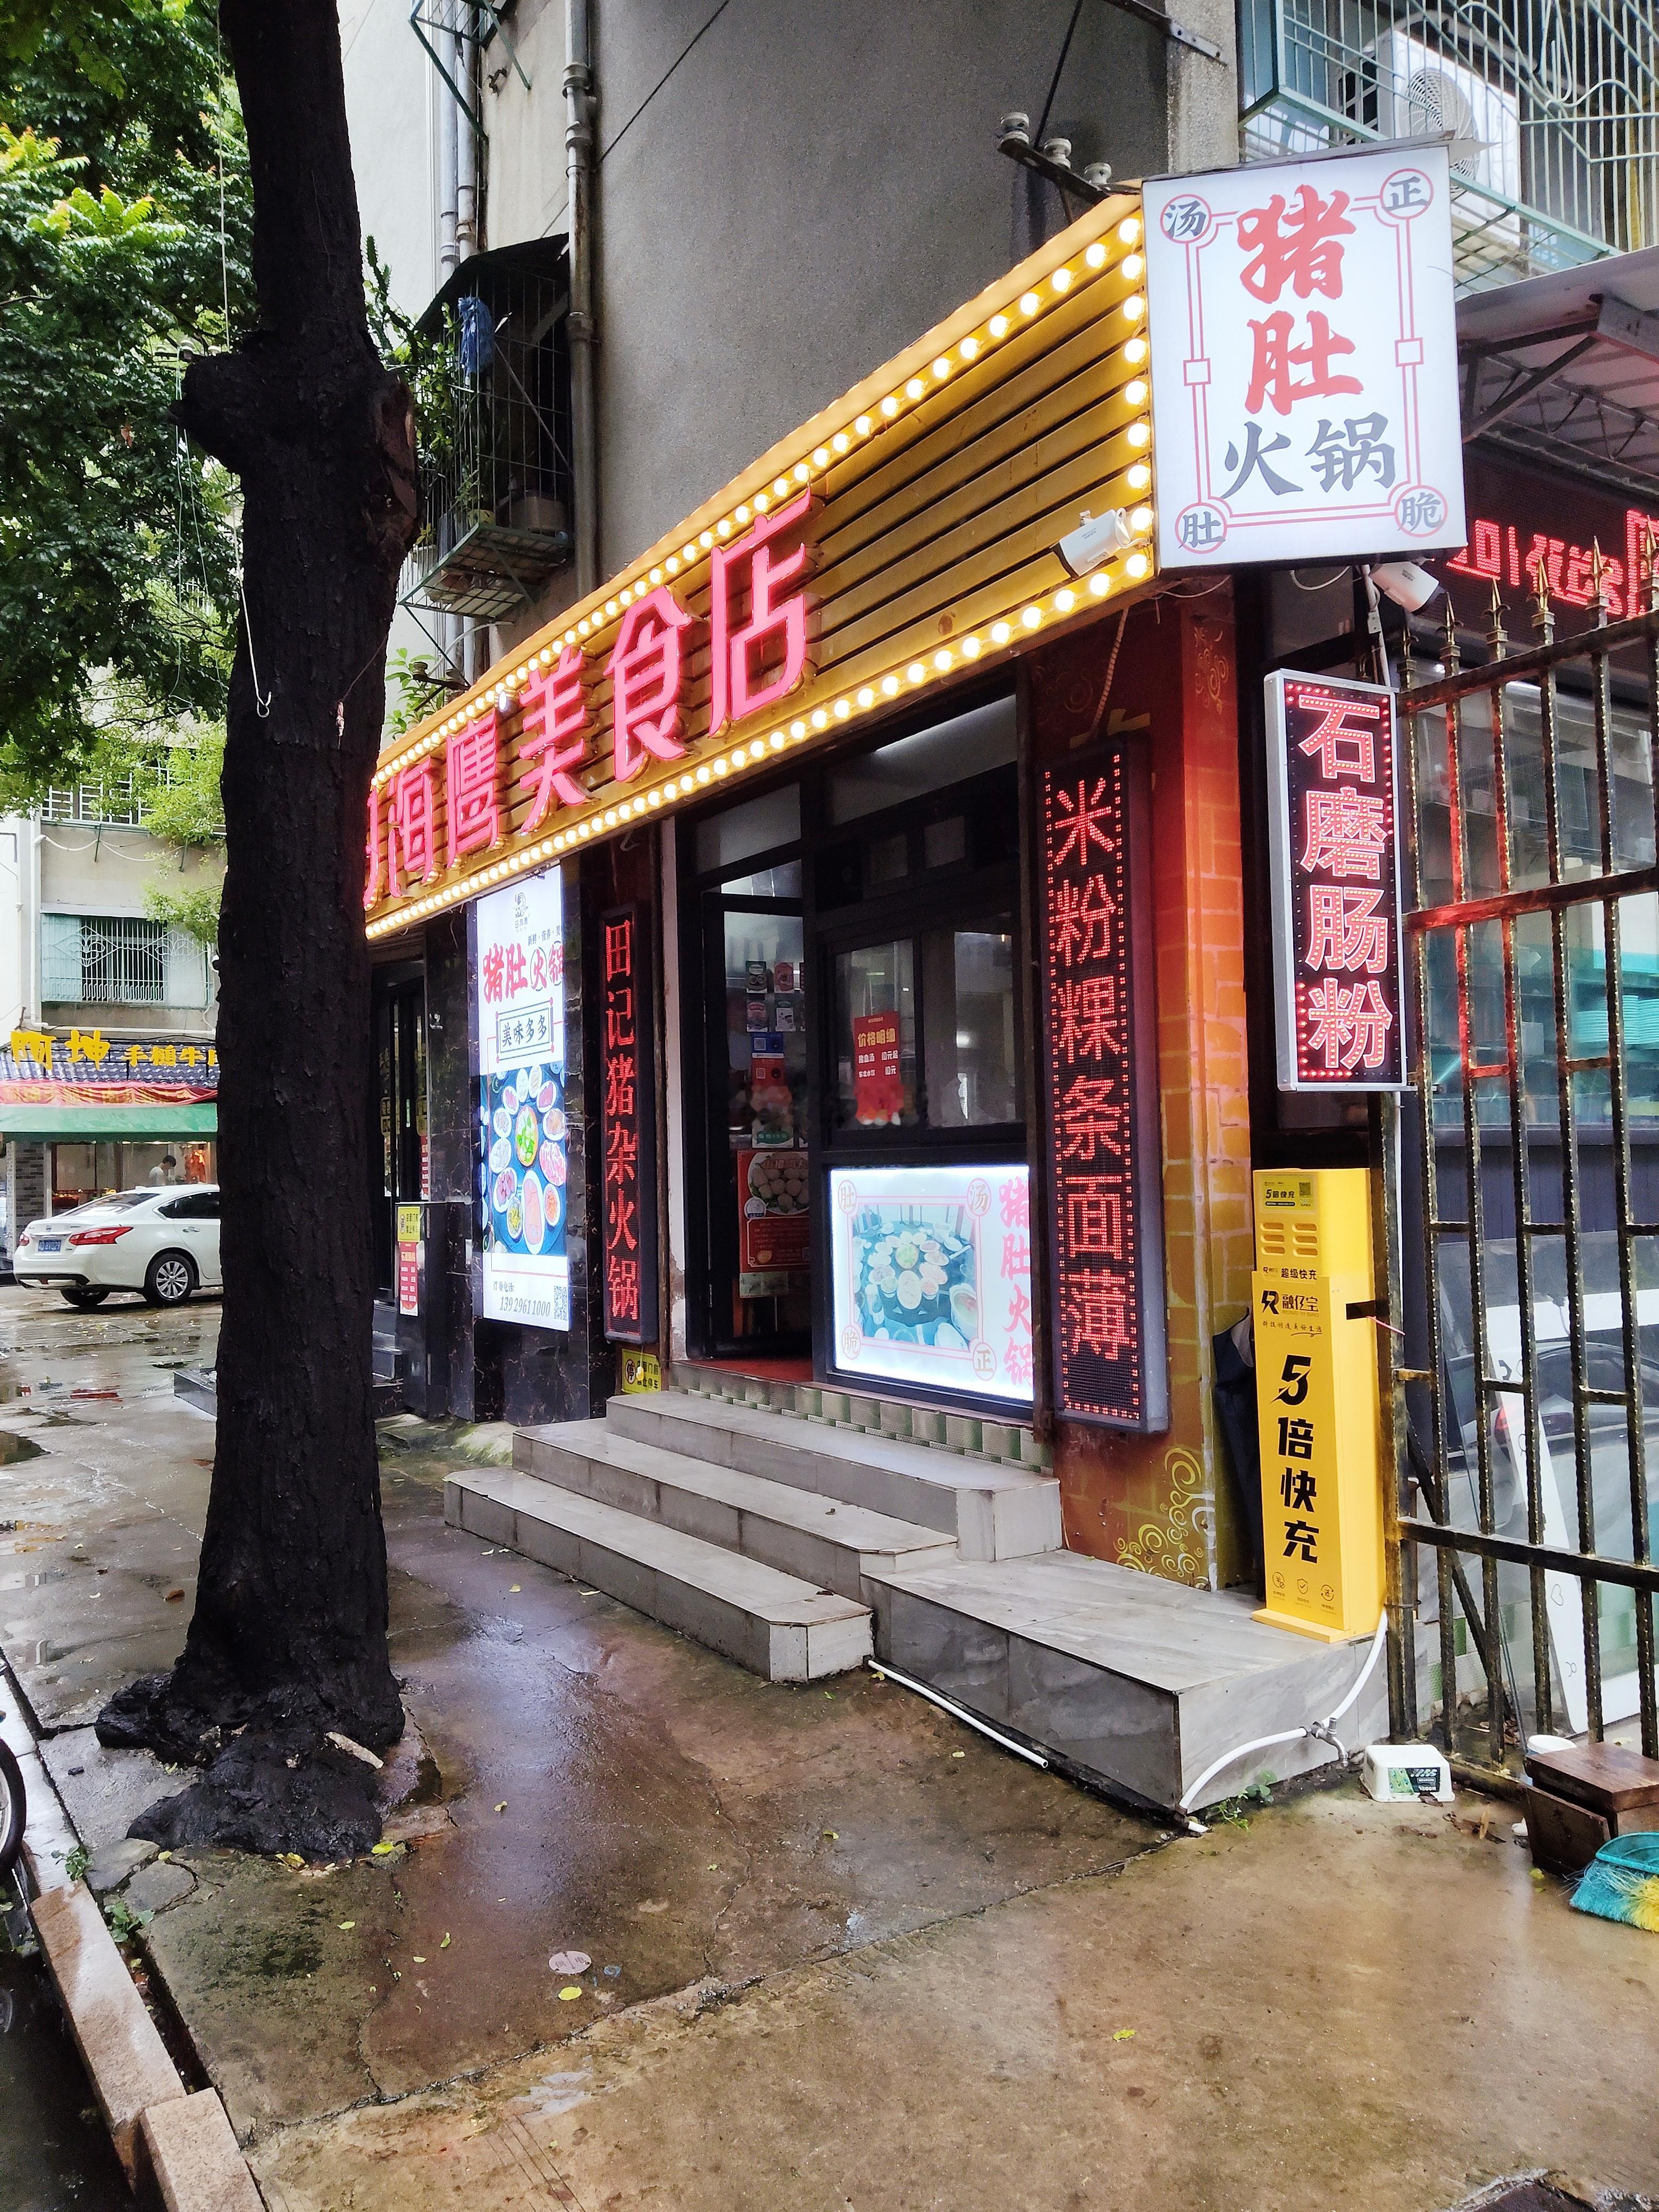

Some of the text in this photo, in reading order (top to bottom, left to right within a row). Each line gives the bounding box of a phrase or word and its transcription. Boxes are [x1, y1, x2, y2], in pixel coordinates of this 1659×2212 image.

[1390, 176, 1429, 212] 正
[1165, 200, 1205, 238] 汤
[1236, 185, 1363, 416] 猪肚
[1221, 412, 1398, 499] 火锅
[1178, 512, 1226, 549] 肚
[1401, 493, 1443, 532] 脆
[1298, 694, 1393, 1069] 石磨肠粉
[483, 943, 565, 1004] 猪肚火锅
[501, 1014, 547, 1048] 美味多多
[858, 1028, 896, 1048] 价格明细
[11, 1029, 111, 1071] 阿坤
[606, 920, 638, 1320] 田记猪杂火锅
[839, 1186, 857, 1211] 肚
[968, 1184, 988, 1212] 汤
[1280, 1268, 1317, 1280] 超级快充
[1282, 1294, 1319, 1312] 融亿宝
[975, 1348, 994, 1374] 正
[1270, 1354, 1319, 1565] 5倍快充
